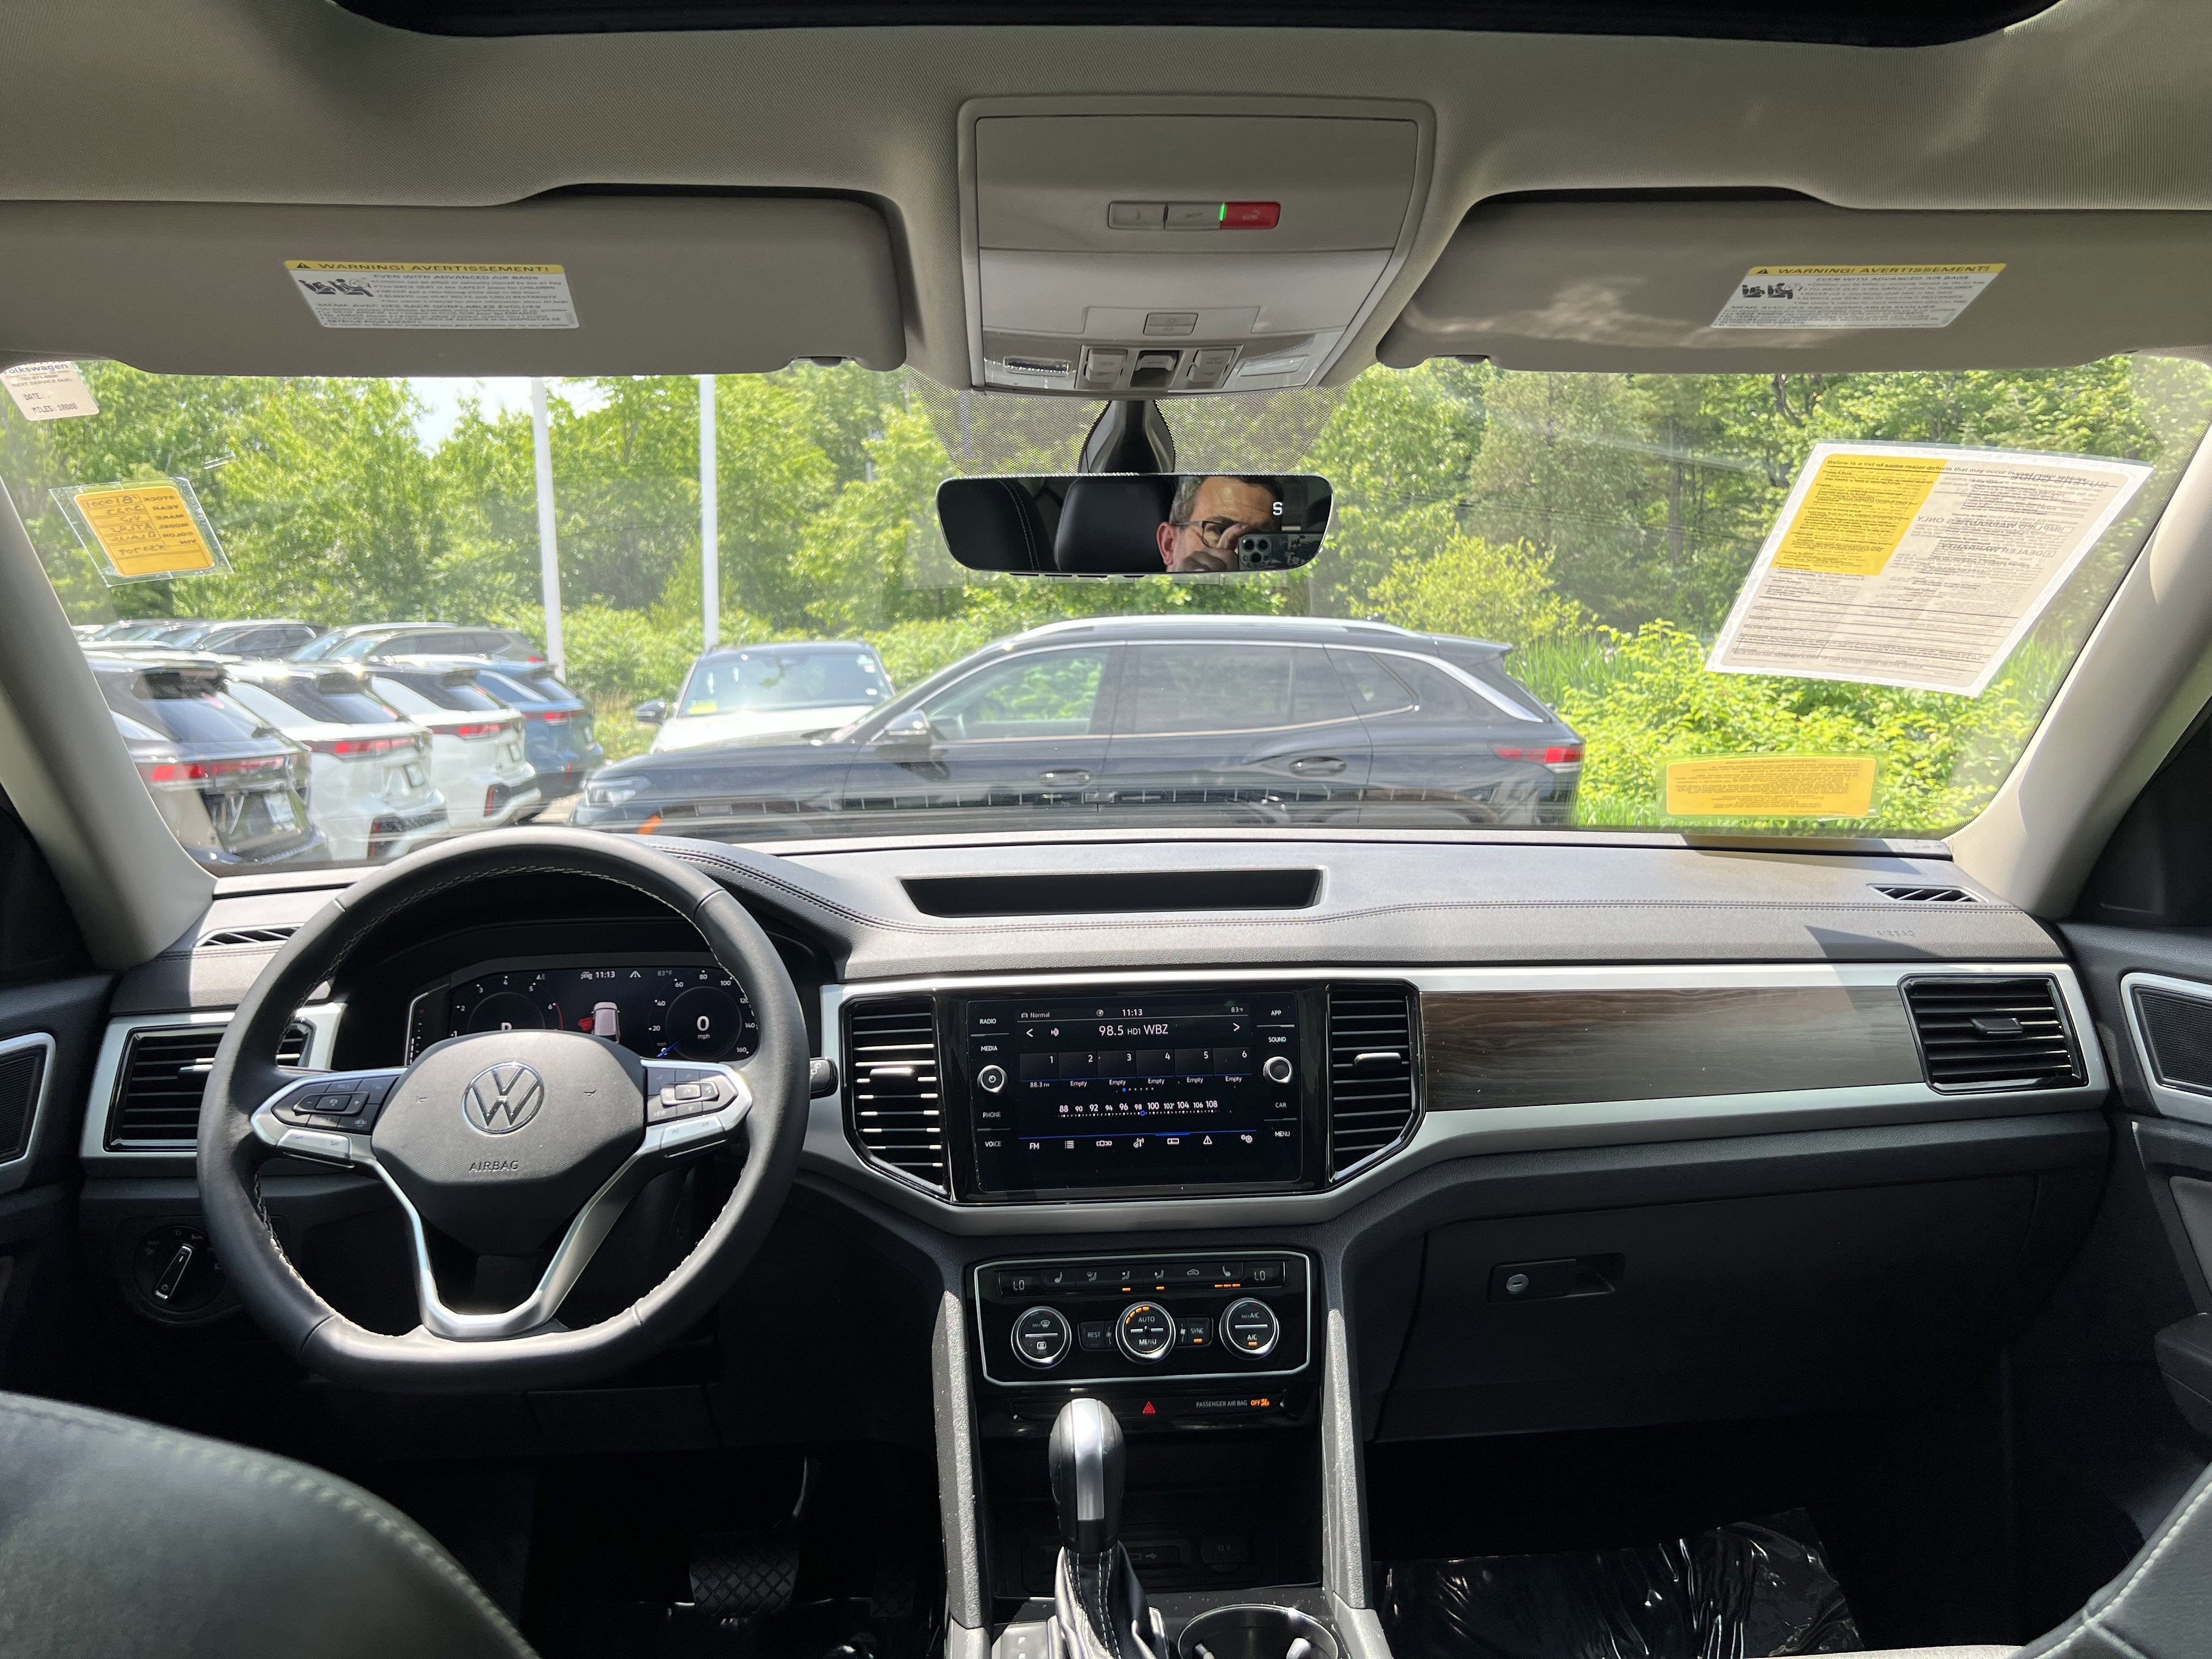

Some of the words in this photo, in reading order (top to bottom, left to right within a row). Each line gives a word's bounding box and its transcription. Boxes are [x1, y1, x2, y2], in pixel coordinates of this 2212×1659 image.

[4, 364, 69, 374] olkswagen
[1272, 501, 1283, 515] S
[1121, 1008, 1143, 1017] 11:13
[697, 1015, 710, 1032] 0
[1099, 1025, 1124, 1036] 98.5
[1143, 1024, 1169, 1035] WBZ
[1088, 1054, 1093, 1063] 2
[1127, 1053, 1132, 1062] 3
[1165, 1052, 1171, 1060] 4
[1204, 1051, 1209, 1059] 5
[1242, 1050, 1248, 1058] 6
[1049, 1056, 1054, 1064] 1
[1059, 1105, 1069, 1113] 88
[1089, 1104, 1098, 1112] 92
[1119, 1103, 1129, 1111] 96
[1147, 1102, 1160, 1110] 100
[1177, 1101, 1190, 1109] 104
[1029, 1142, 1040, 1150] FM
[469, 1159, 519, 1172] AIRBAG
[1253, 1269, 1266, 1282] LO
[1013, 1279, 1025, 1291] LO
[1196, 1400, 1227, 1408] PASSENGER
[1018, 1637, 1026, 1645] P
